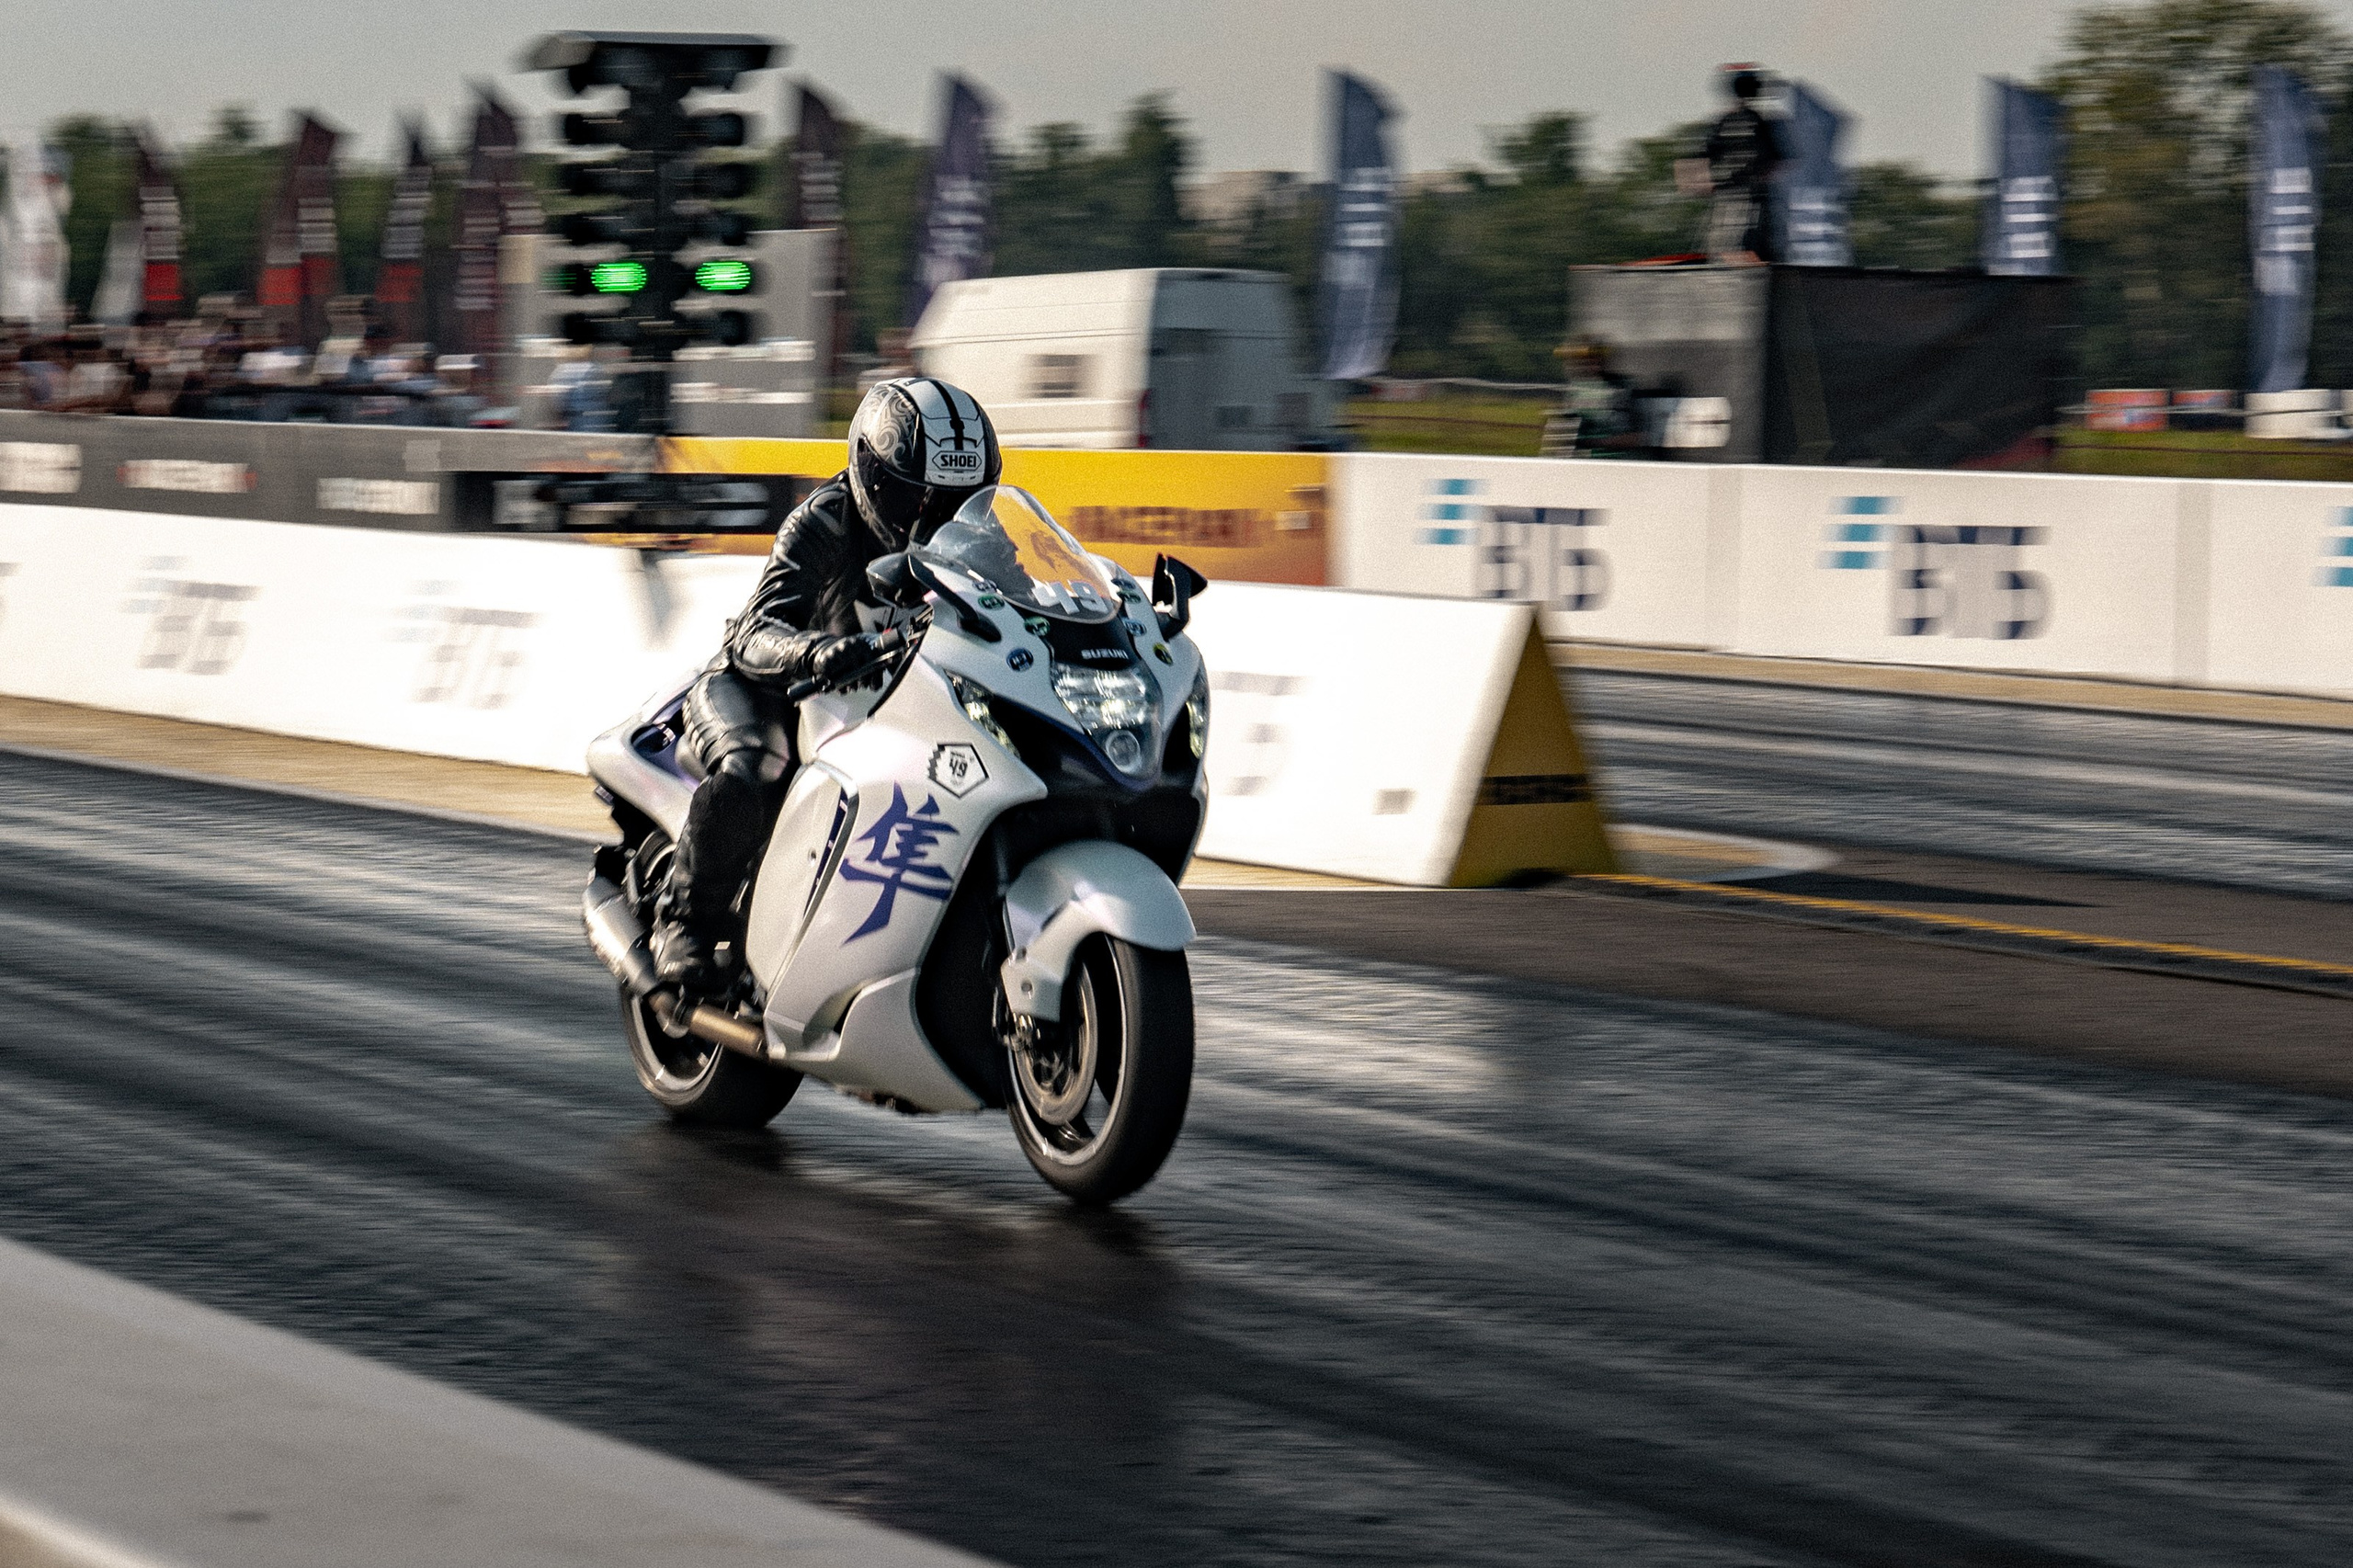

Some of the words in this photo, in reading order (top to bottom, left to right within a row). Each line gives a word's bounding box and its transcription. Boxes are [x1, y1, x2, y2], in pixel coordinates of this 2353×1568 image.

[940, 455, 977, 468] SHOEI
[1030, 579, 1108, 615] 49
[1081, 648, 1129, 660] SUZUKI
[949, 758, 968, 778] 49
[839, 781, 960, 947] 隼
